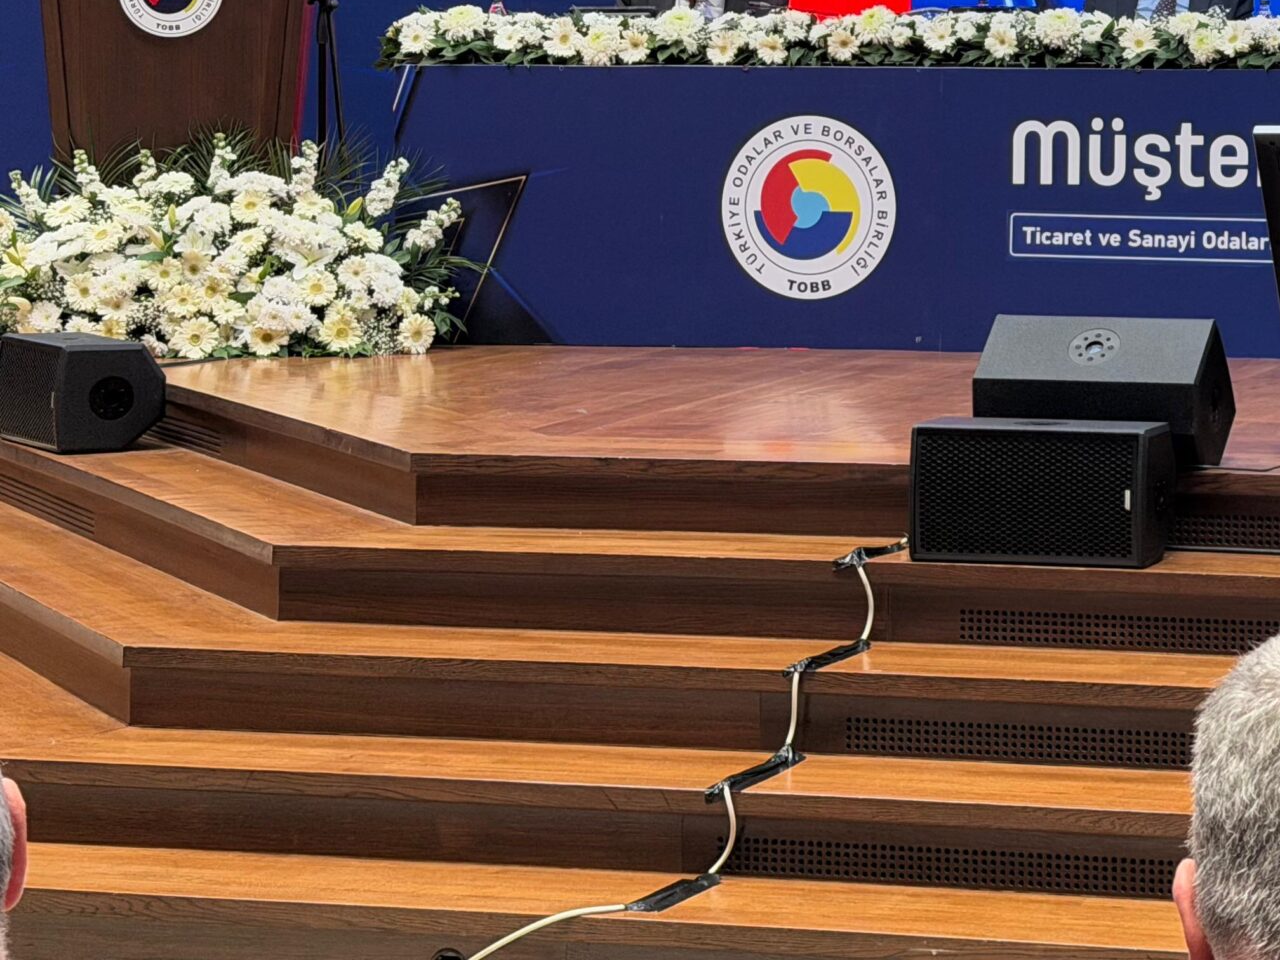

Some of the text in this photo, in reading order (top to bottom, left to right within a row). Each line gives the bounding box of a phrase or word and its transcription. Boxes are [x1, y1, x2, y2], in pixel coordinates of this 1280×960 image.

[156, 23, 181, 31] TOBB
[790, 123, 812, 136] VE
[732, 129, 784, 188] ODALAR
[821, 125, 887, 201] BORSALAR
[1013, 117, 1261, 201] Müşte
[728, 196, 766, 275] TÜRKİYE
[1023, 227, 1271, 252] Ticaret ve Sanayi Odalar
[787, 279, 832, 293] TOBB
